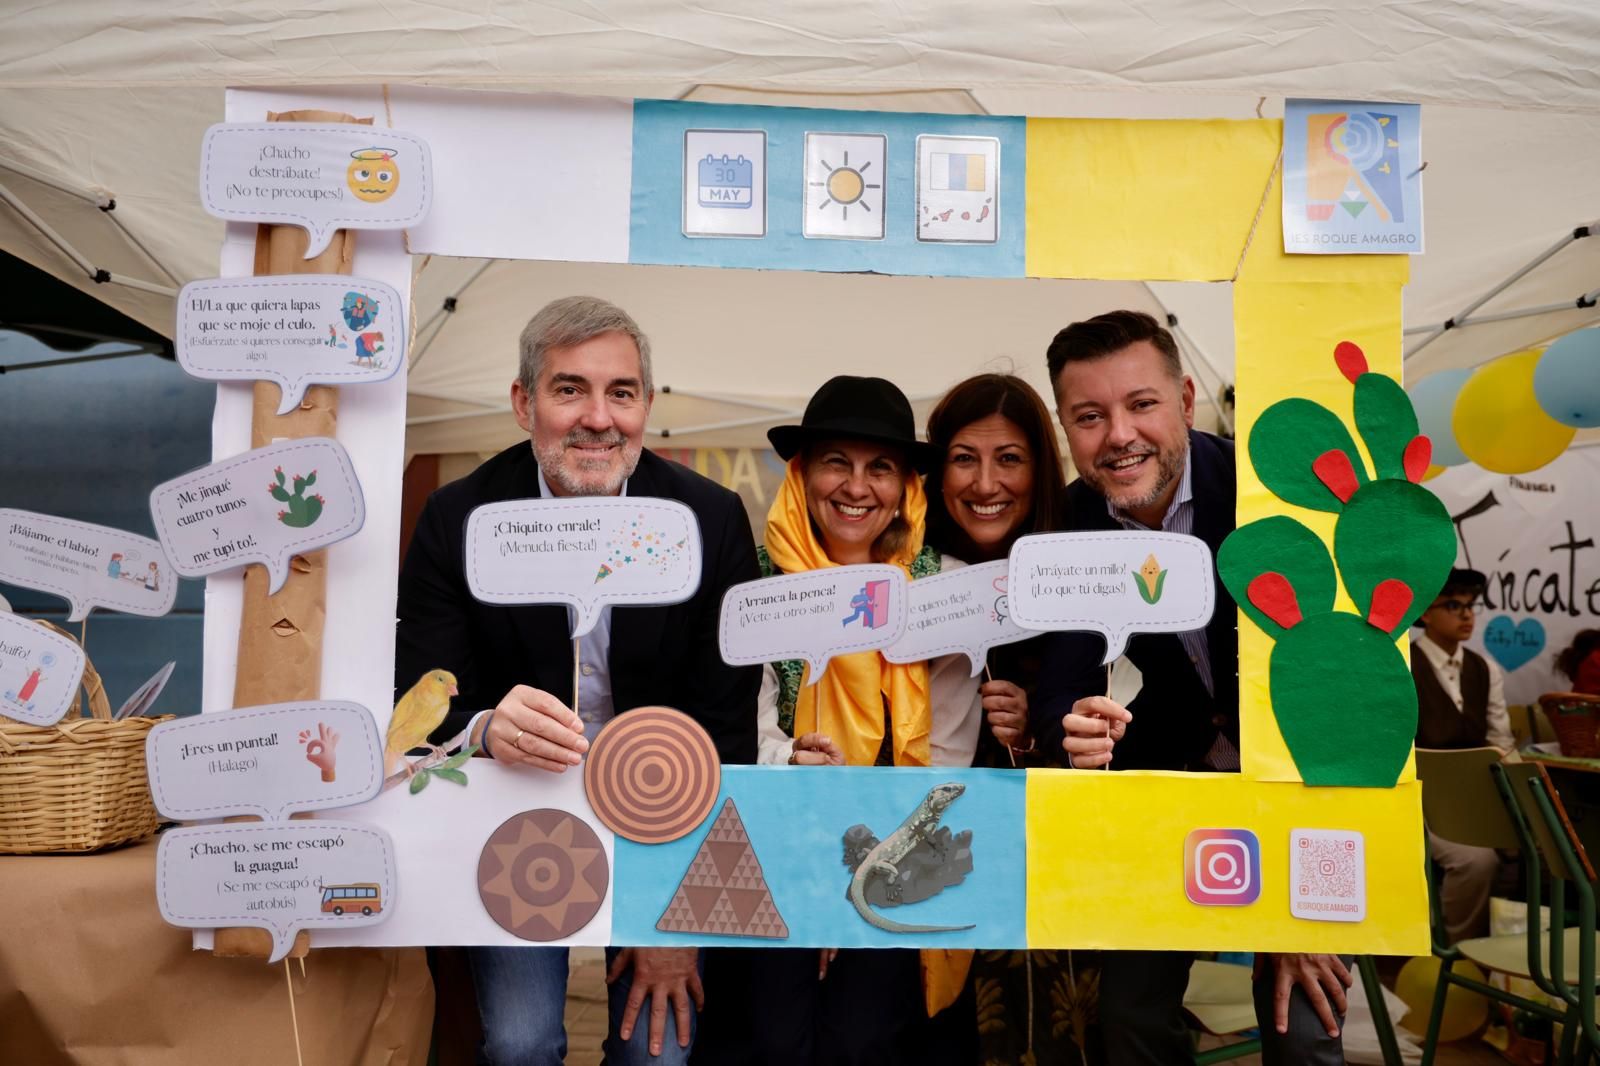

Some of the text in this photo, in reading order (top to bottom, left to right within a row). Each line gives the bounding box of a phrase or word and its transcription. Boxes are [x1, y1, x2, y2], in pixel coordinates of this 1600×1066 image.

[259, 145, 311, 161] ¡Chacho
[249, 166, 321, 181] destrábate!
[715, 167, 736, 184] 30
[255, 186, 269, 197] te
[271, 186, 344, 201] preocupes!)
[709, 188, 741, 201] MAY
[1291, 233, 1417, 244] IES ROQUE AMAGRO
[191, 299, 321, 317] El/La que quiera lapas
[198, 318, 316, 333] que se moje el culo.
[176, 478, 232, 510] ¡Me jinqué
[176, 497, 248, 528] cuatro tunos
[212, 527, 220, 540] y
[494, 518, 601, 538] ¡Chiquito enrale!
[9, 523, 100, 558] ¡Bájame el labio!
[499, 538, 598, 557] (¡Menuda fiesta!)
[193, 551, 212, 564] me
[213, 539, 236, 558] tupí
[1030, 563, 1127, 580] ¡Arráyate un millo!
[738, 584, 837, 611] ¡Arranca la penca!
[1055, 585, 1076, 597] que
[1079, 582, 1090, 595] tú
[1092, 581, 1127, 597] digas!)
[773, 612, 781, 621] a
[783, 606, 807, 619] otro
[809, 601, 835, 616] sitio!)
[180, 733, 280, 760] ¡Eres un puntal!
[208, 757, 259, 776] (Halago)
[253, 841, 269, 852] se
[271, 840, 293, 851] me
[297, 835, 345, 853] escapó
[234, 858, 299, 875] la guagua!
[242, 881, 262, 892] me
[265, 876, 310, 891] escapó
[246, 897, 297, 911] autobús)
